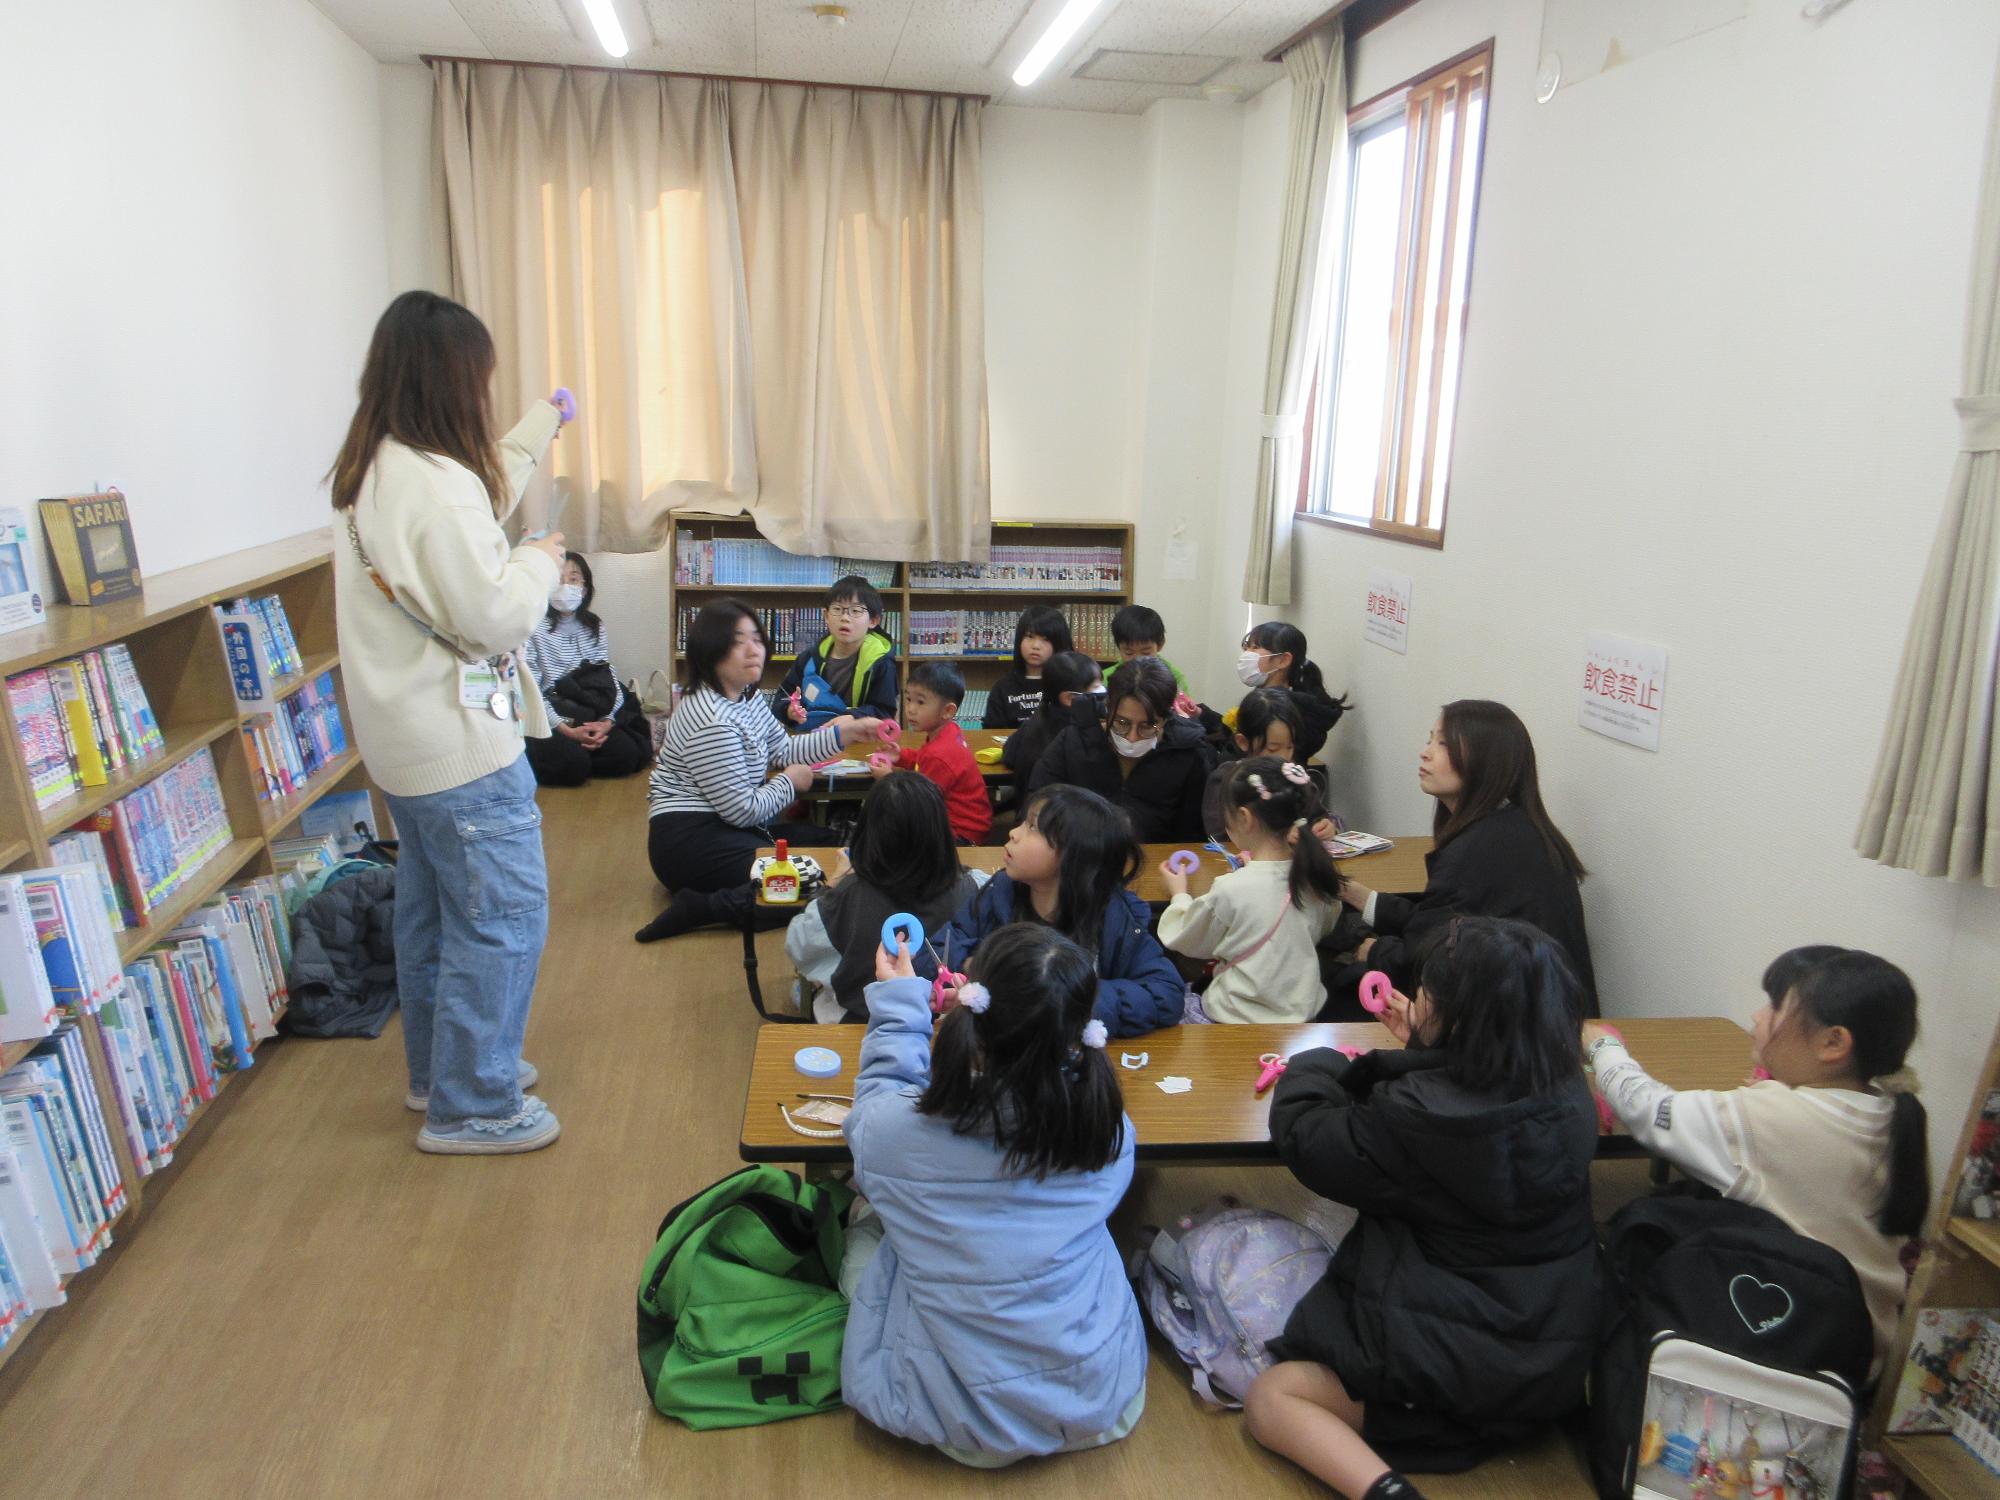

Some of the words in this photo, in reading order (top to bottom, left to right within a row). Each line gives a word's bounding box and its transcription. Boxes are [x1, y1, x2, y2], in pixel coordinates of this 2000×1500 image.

[73, 500, 128, 528] SAFARI
[1367, 592, 1407, 624] 飲食禁止
[1584, 662, 1658, 710] 飲食禁止
